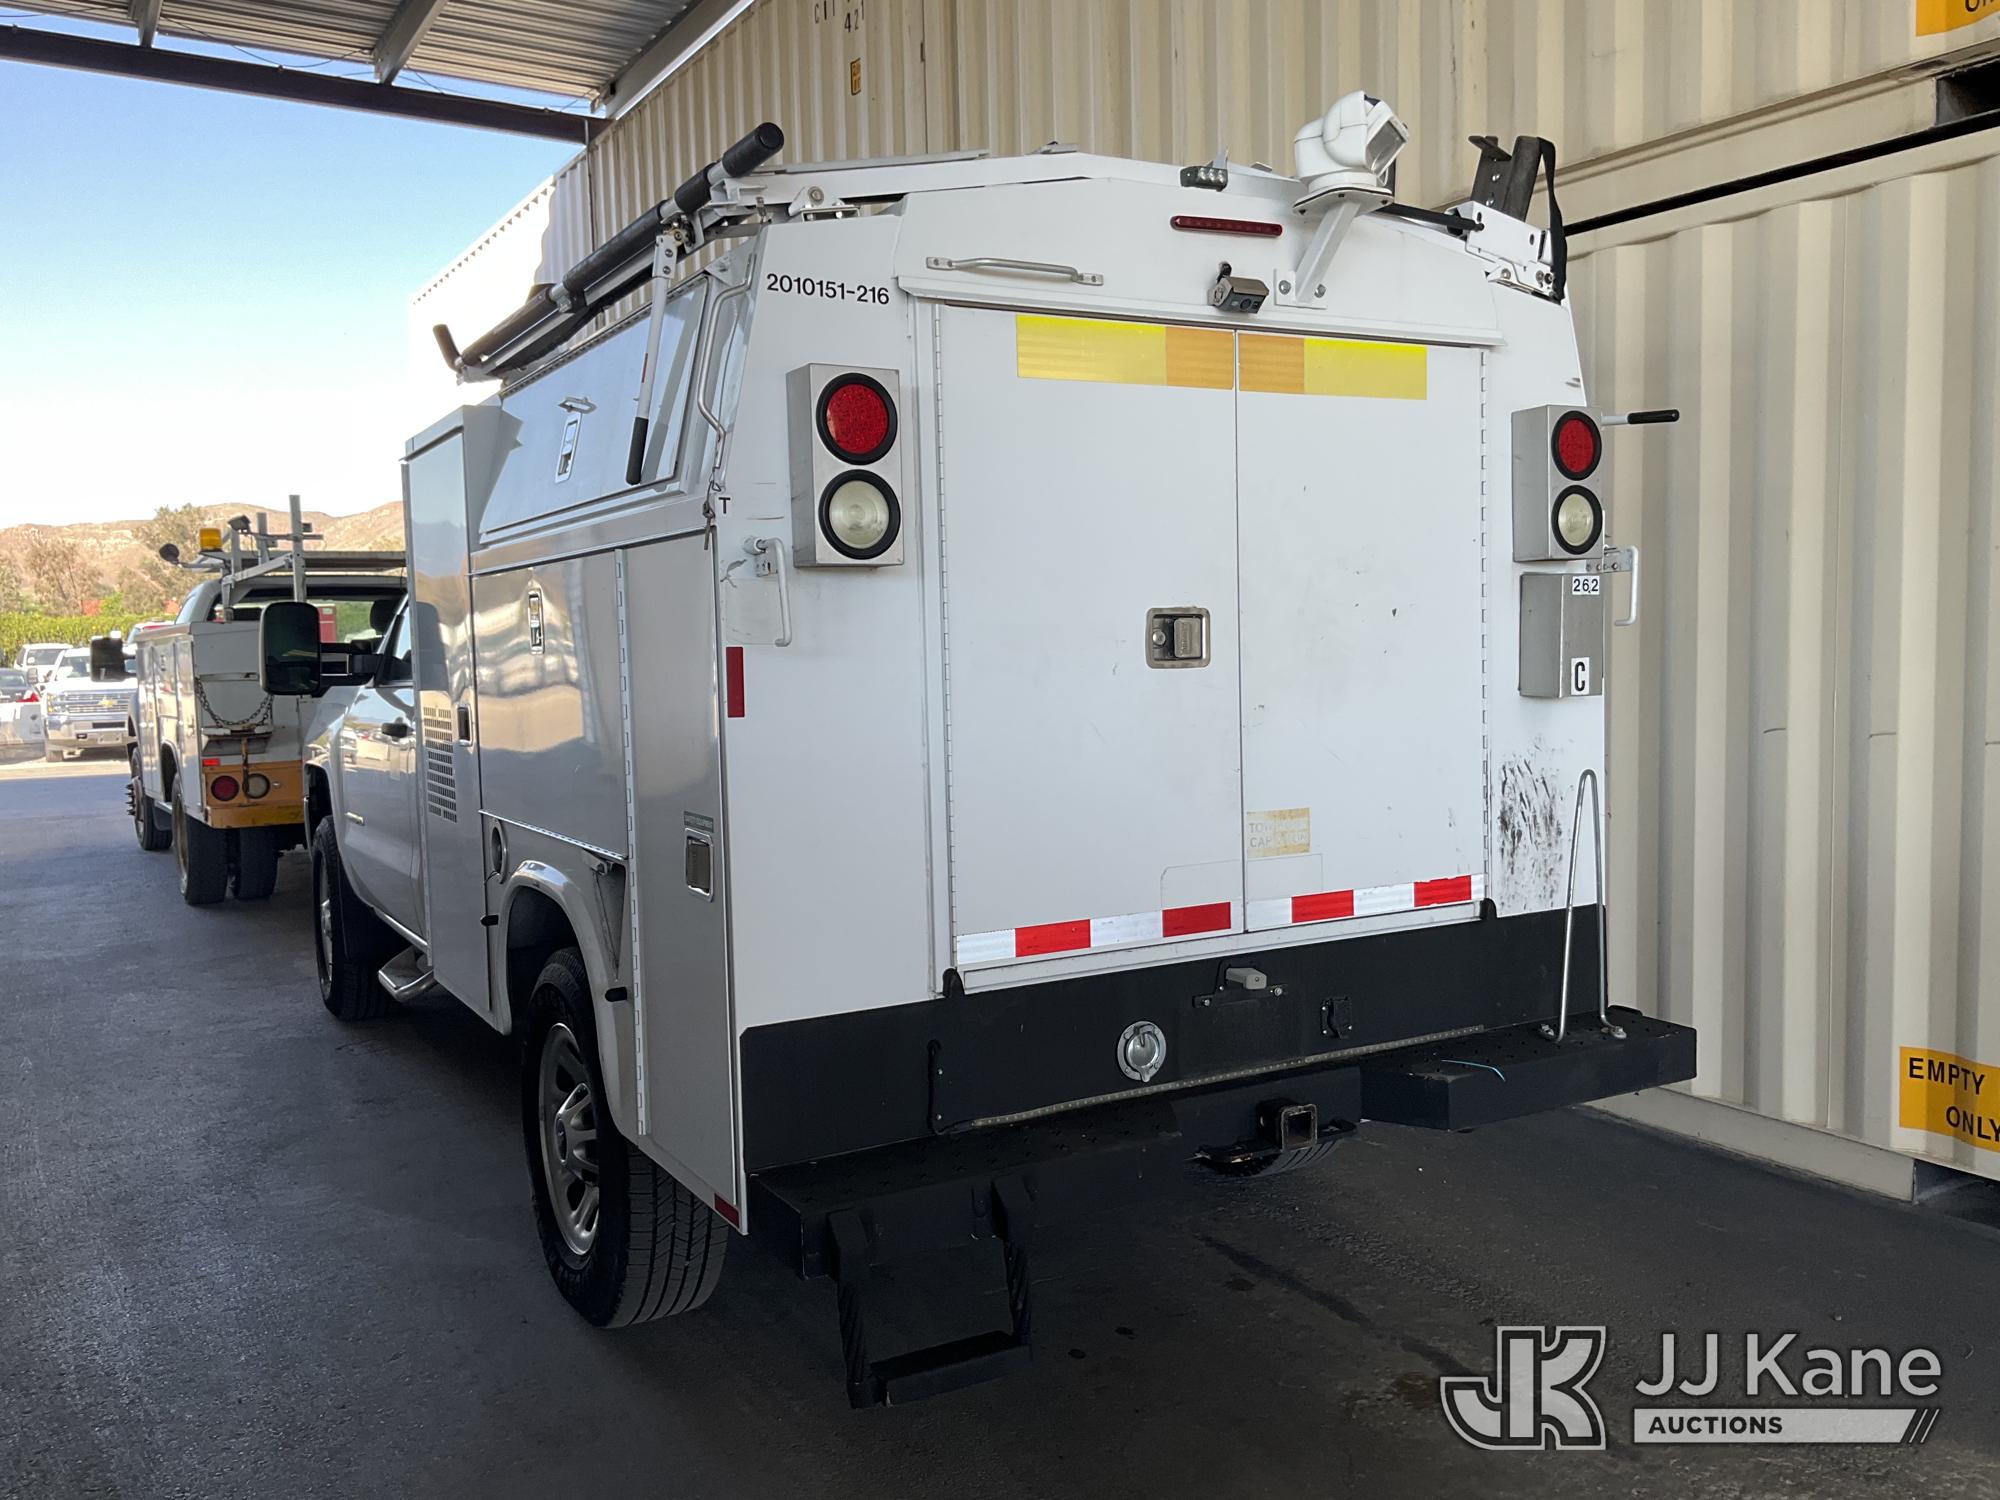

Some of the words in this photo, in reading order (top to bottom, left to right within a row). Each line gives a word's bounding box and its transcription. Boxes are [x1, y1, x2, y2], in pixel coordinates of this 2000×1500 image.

[766, 273, 890, 305] 2010151-216
[718, 496, 731, 515] T
[1574, 661, 1586, 692] C
[1908, 1056, 1985, 1095] EMPTY
[1945, 1105, 2000, 1142] ONLY
